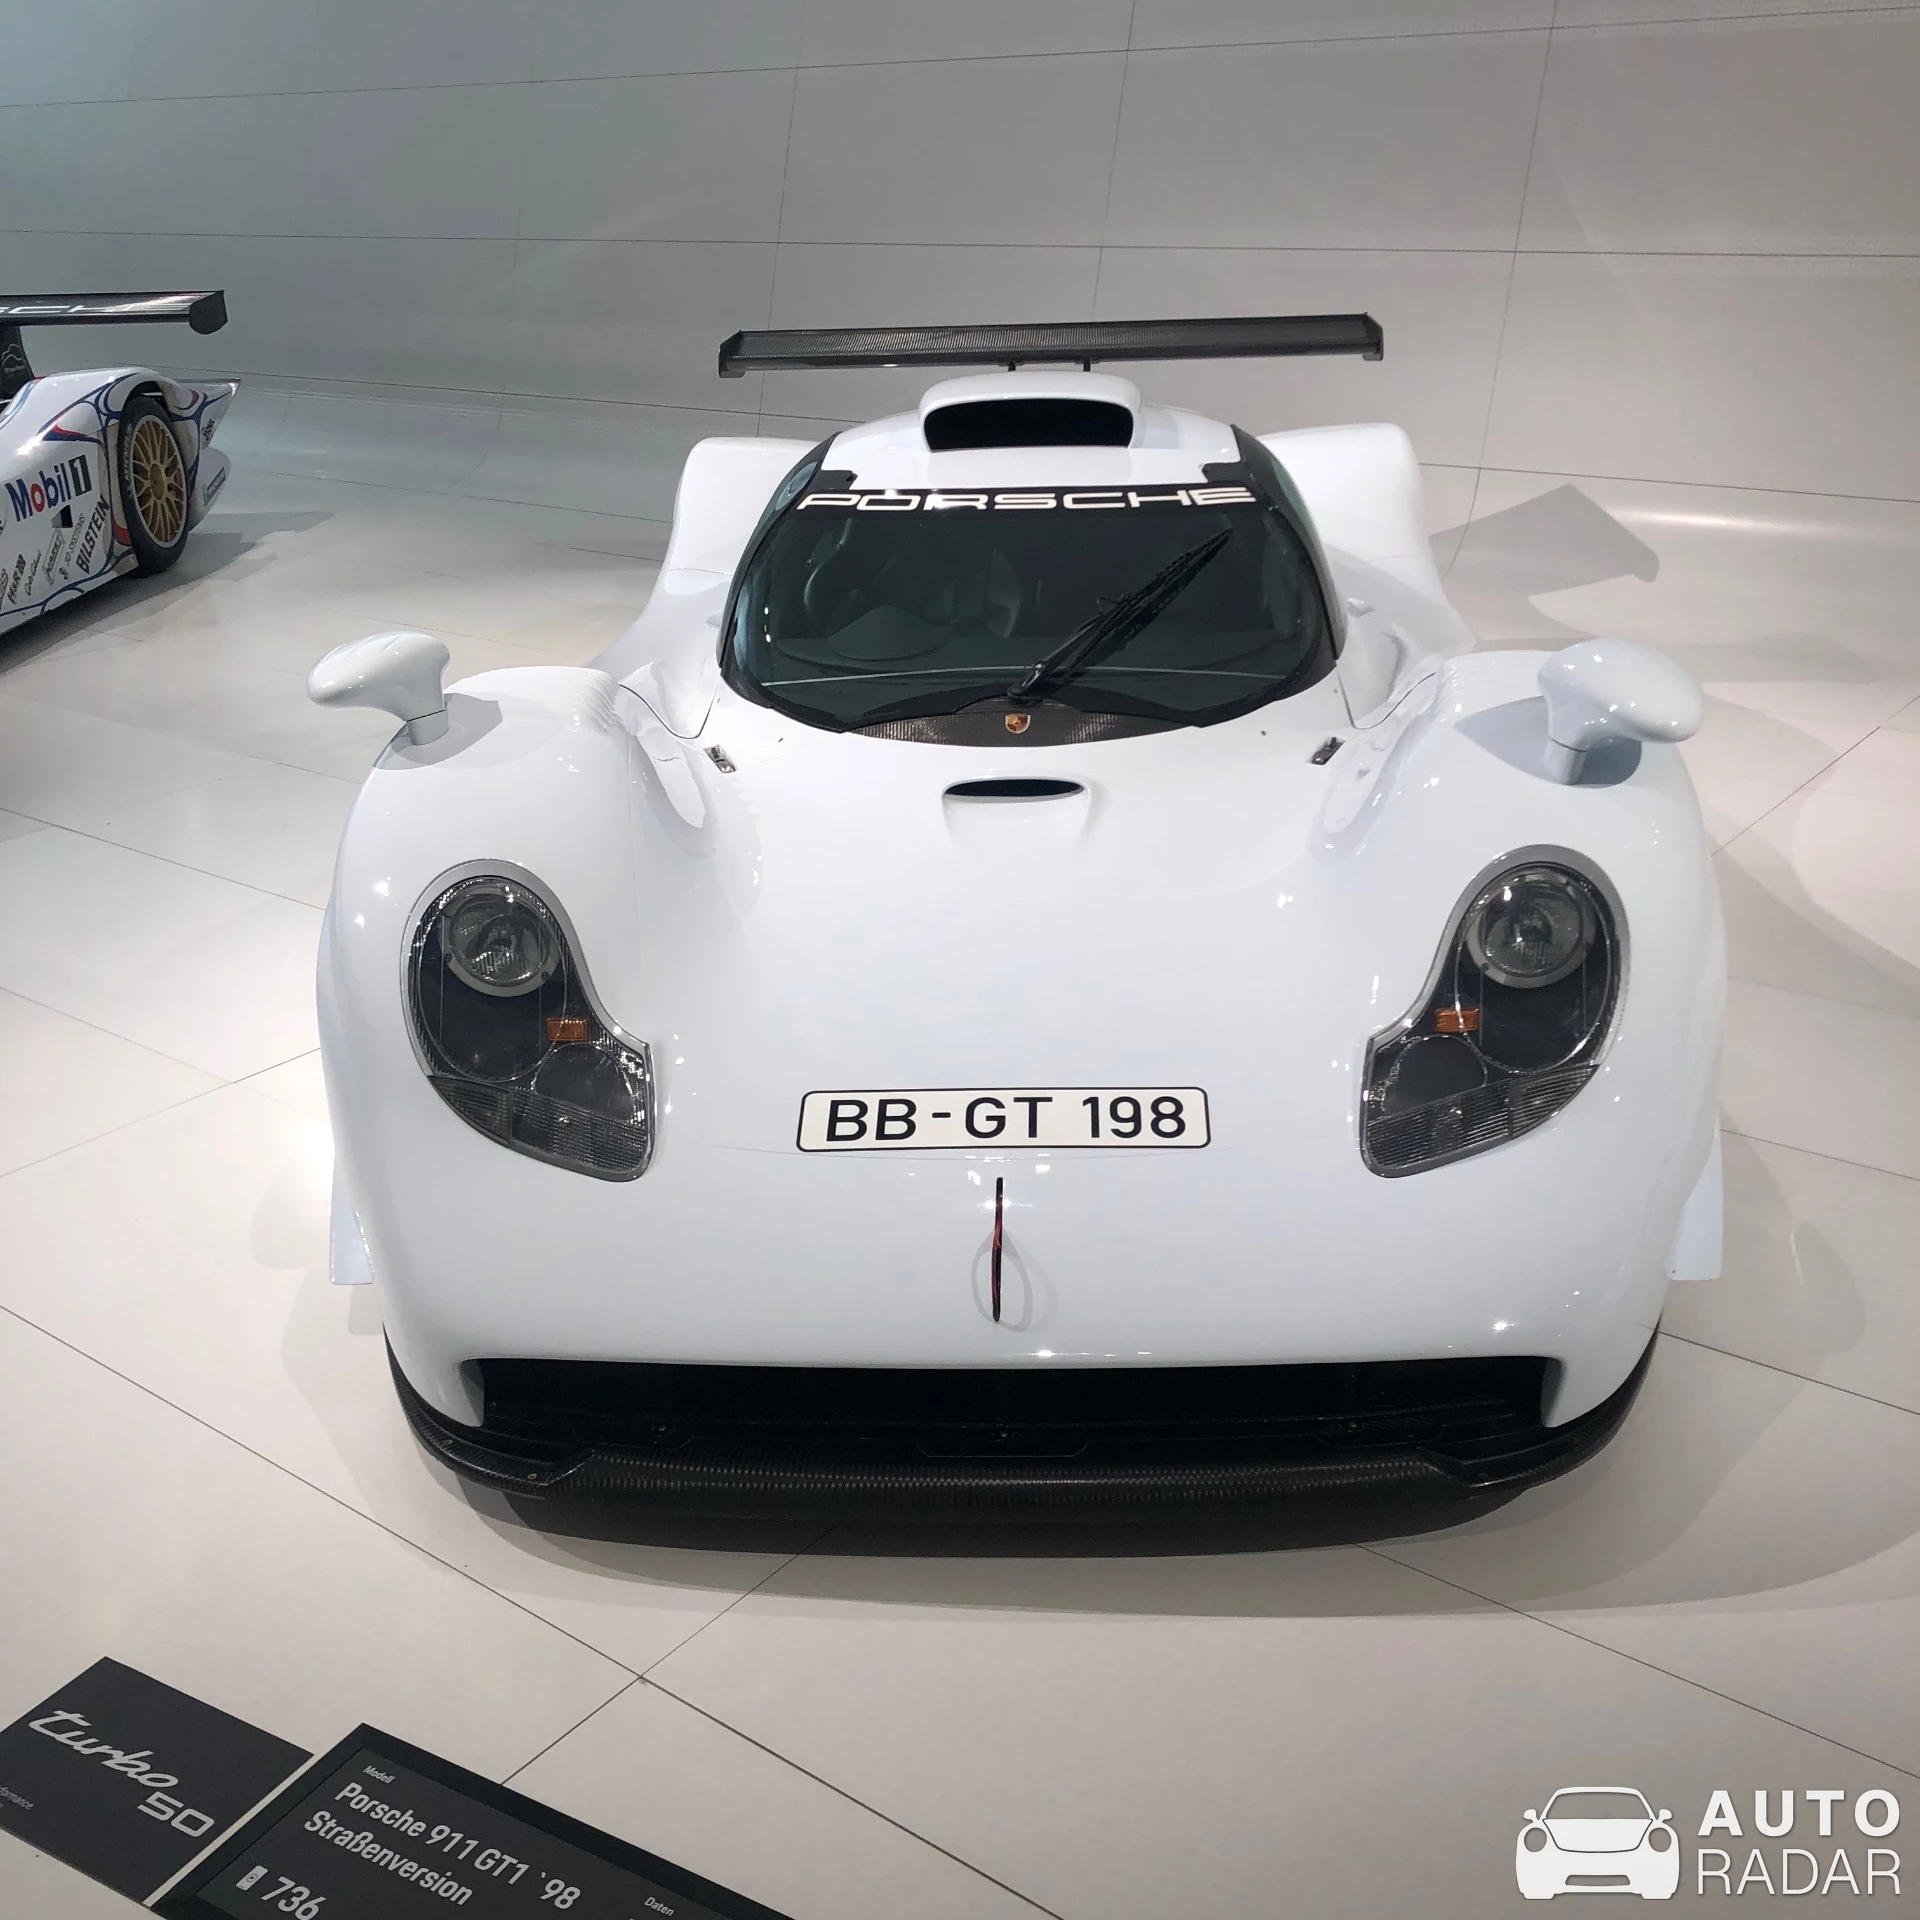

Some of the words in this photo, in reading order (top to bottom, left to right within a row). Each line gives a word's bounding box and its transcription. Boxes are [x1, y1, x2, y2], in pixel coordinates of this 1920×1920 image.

[0, 302, 192, 314] CHE
[4, 463, 72, 522] Mobil
[797, 487, 1256, 511] PORSCHE
[76, 494, 110, 574] BILSTEIN
[1082, 1096, 1186, 1139] 198
[28, 1710, 178, 1788] turbo
[363, 1765, 396, 1784] Modell
[137, 1791, 215, 1837] 50
[335, 1782, 427, 1837] Porsche
[425, 1824, 479, 1860] 911
[474, 1849, 530, 1885] GT1
[304, 1810, 473, 1905] Straßenversion
[260, 1876, 327, 1920] 736
[644, 1896, 675, 1917] Daten
